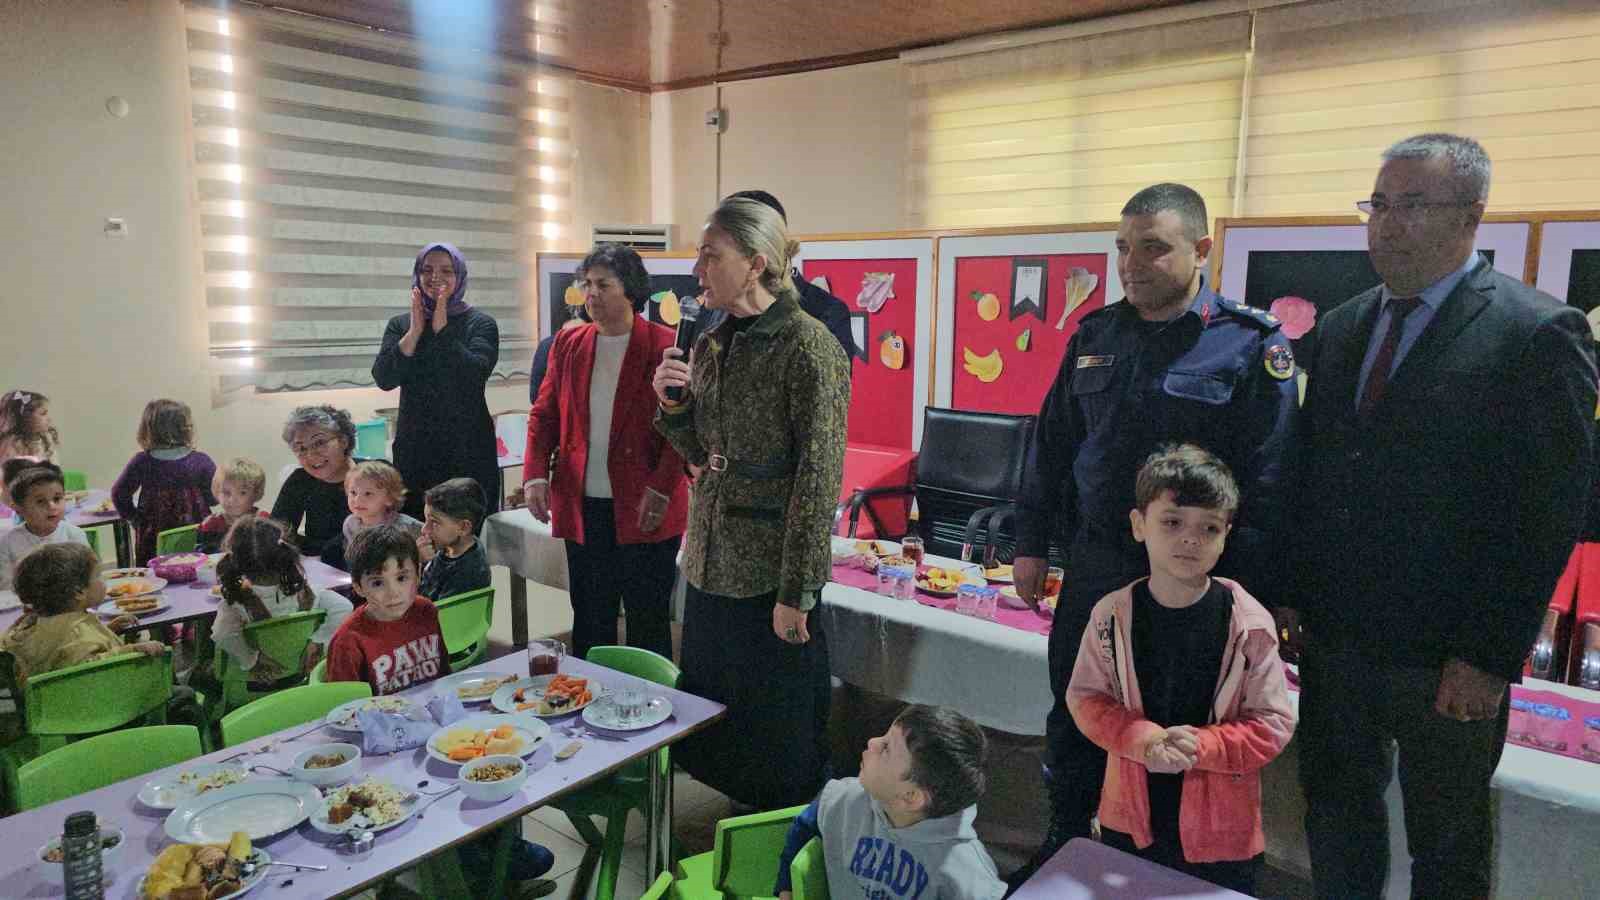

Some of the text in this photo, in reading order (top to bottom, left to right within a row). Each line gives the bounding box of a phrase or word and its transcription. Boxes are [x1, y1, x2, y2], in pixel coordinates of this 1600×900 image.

[372, 634, 440, 684] PAW
[376, 658, 442, 696] PATRO
[849, 836, 929, 899] READY
